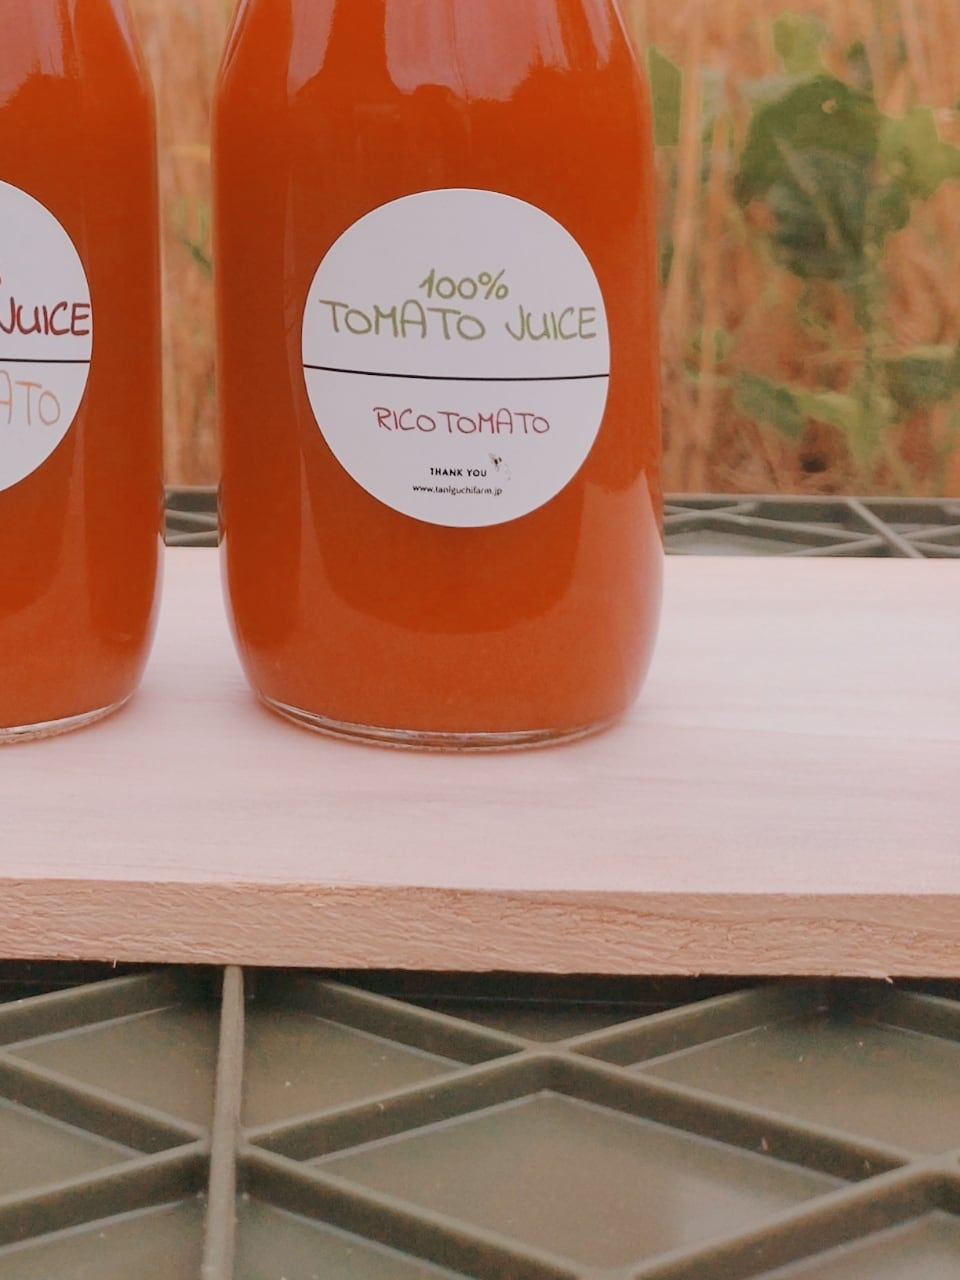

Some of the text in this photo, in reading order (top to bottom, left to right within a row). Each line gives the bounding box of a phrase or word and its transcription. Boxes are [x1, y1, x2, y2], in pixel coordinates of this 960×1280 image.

[418, 268, 509, 300] 100%
[319, 299, 597, 341] TOMATO JUICE
[430, 467, 487, 477] THANK YOU
[412, 485, 503, 496] www.taniguchifarm.jp
